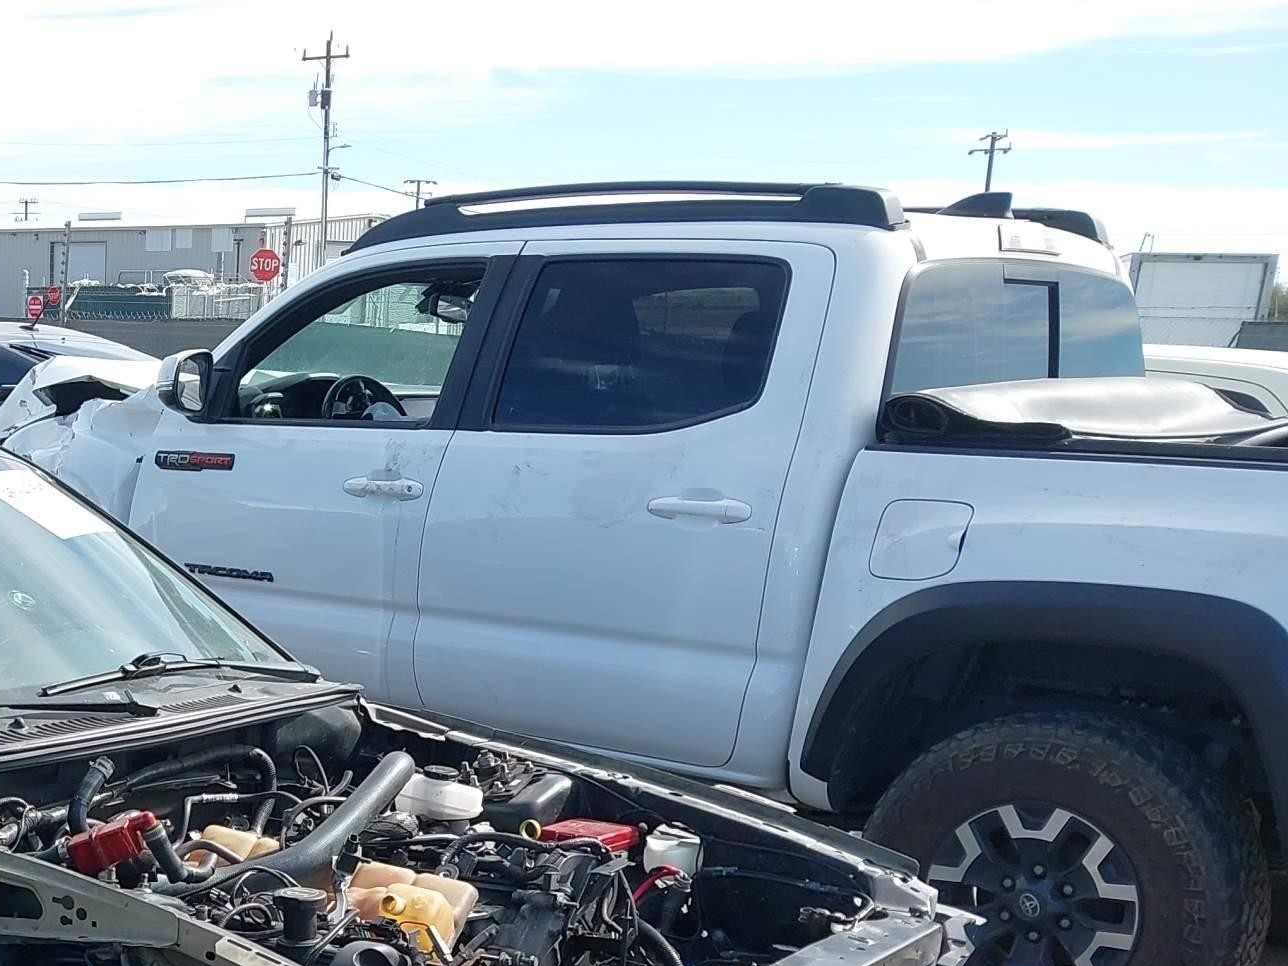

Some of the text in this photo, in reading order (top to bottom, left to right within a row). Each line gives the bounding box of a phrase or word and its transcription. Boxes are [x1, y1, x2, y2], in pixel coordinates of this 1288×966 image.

[251, 257, 279, 272] STOP
[157, 453, 231, 466] TRD SPORT
[184, 562, 274, 583] TACOMA
